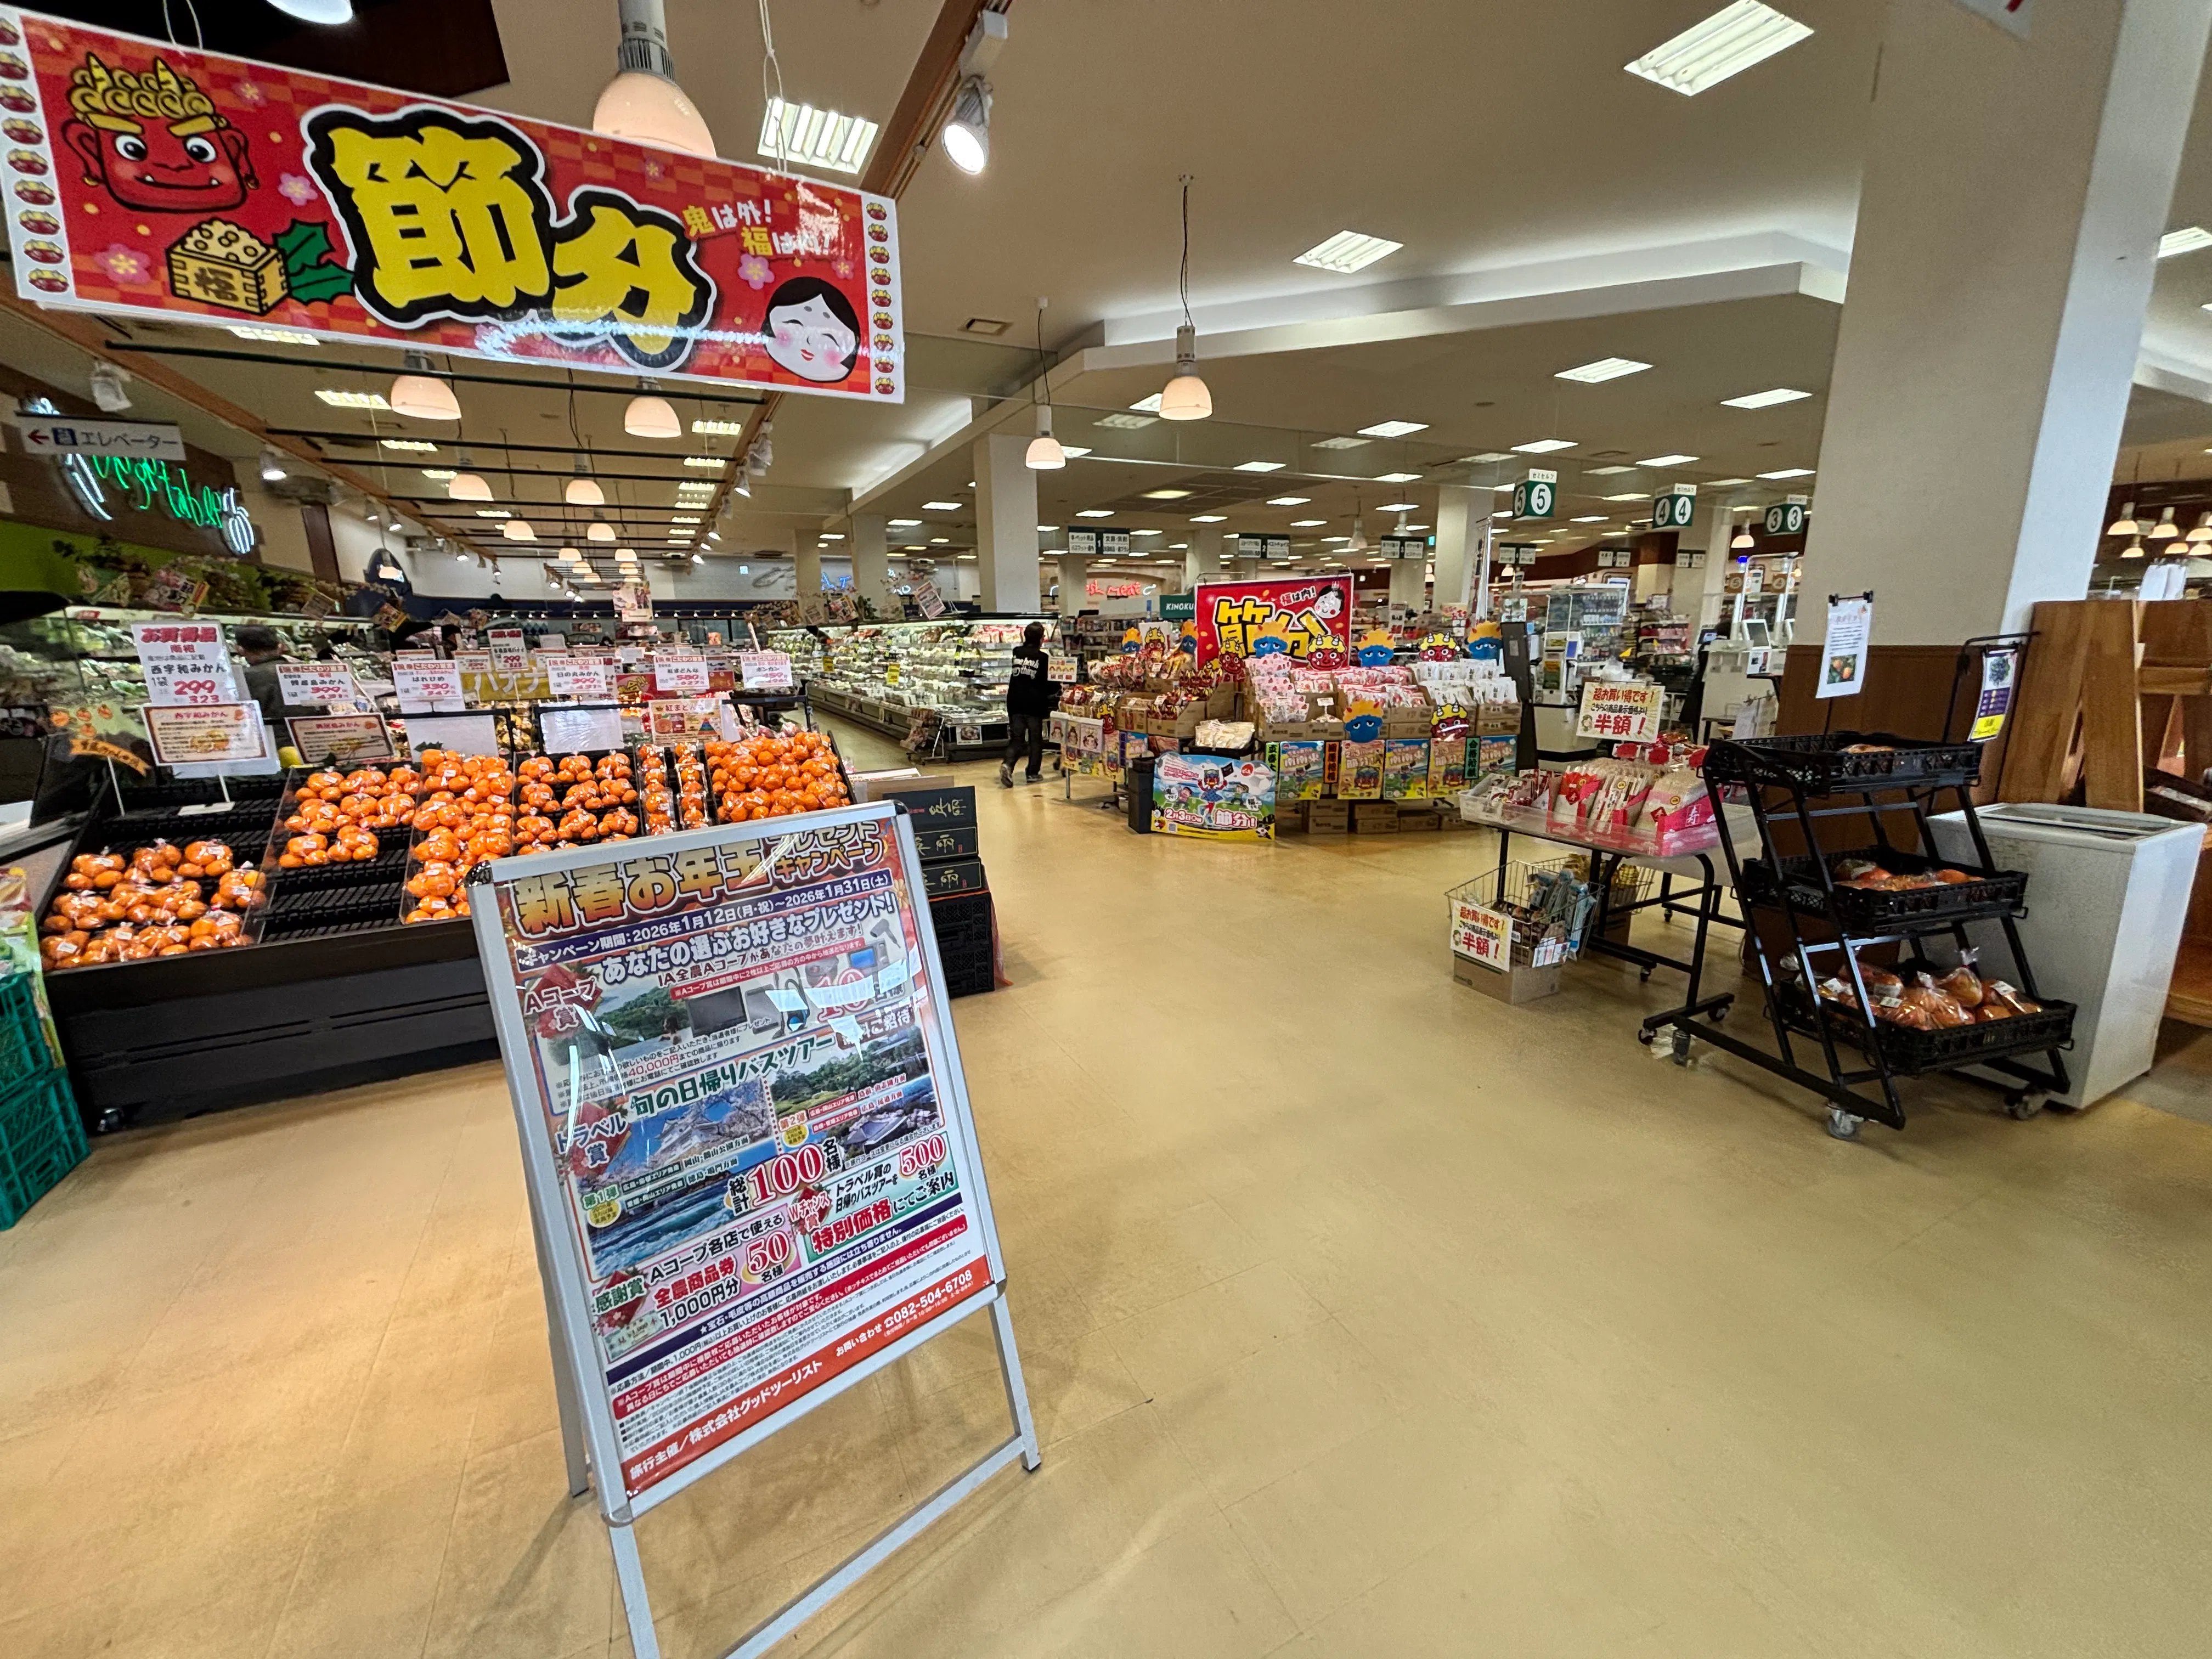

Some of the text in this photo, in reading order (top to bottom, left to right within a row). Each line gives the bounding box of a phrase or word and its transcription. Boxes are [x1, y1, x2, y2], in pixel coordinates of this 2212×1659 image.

[682, 199, 771, 237] 鬼は外!
[328, 125, 697, 355] 節分
[81, 432, 177, 448] エレベーター
[1517, 492, 1524, 512] 5
[1537, 488, 1545, 510] 5
[1658, 505, 1667, 519] 4
[1678, 500, 1687, 517] 4
[1771, 513, 1779, 527] 3
[1791, 509, 1799, 525] 3
[1280, 586, 1316, 605] 福は内!
[1216, 598, 1328, 657] 節分
[503, 655, 521, 663] 299
[173, 679, 216, 695] 299
[188, 695, 220, 704] 323
[1593, 687, 1655, 703] 超お買い得です!
[1594, 713, 1646, 736] 半額!
[1215, 809, 1257, 827] 節分!
[772, 840, 883, 882] キャンペーン
[511, 839, 771, 936] 新春お年玉
[1459, 906, 1505, 931] 超お買い得です!
[600, 892, 895, 984] あなたの選ぶお好きなプレゼント!
[1462, 932, 1500, 960] 半額!
[552, 1002, 582, 1030] 賞
[630, 1029, 834, 1120] 旬の日帰りバスツアー
[778, 1110, 808, 1131] 第2弾
[585, 1139, 609, 1167] 賞
[898, 1132, 947, 1177] 500
[729, 1137, 841, 1214] 総計 100 名様
[834, 1160, 891, 1197] トラベル賞の
[917, 1164, 937, 1181] 名様
[582, 1183, 619, 1210] 第1弾
[834, 1171, 899, 1213] 日帰りバスツアーを
[789, 1190, 831, 1223] Wチャンス
[811, 1169, 955, 1256] 特別価格 にてご案内
[805, 1212, 820, 1232] 賞
[648, 1209, 783, 1285] Aコープ各店で使える
[745, 1227, 792, 1276] 50
[653, 1254, 736, 1311] 全農商品券
[760, 1263, 784, 1284] 名様
[595, 1277, 644, 1314] 感謝賞
[661, 1276, 740, 1330] 1,000円分
[836, 1268, 972, 1358] お問い合わせ 082-504-6708
